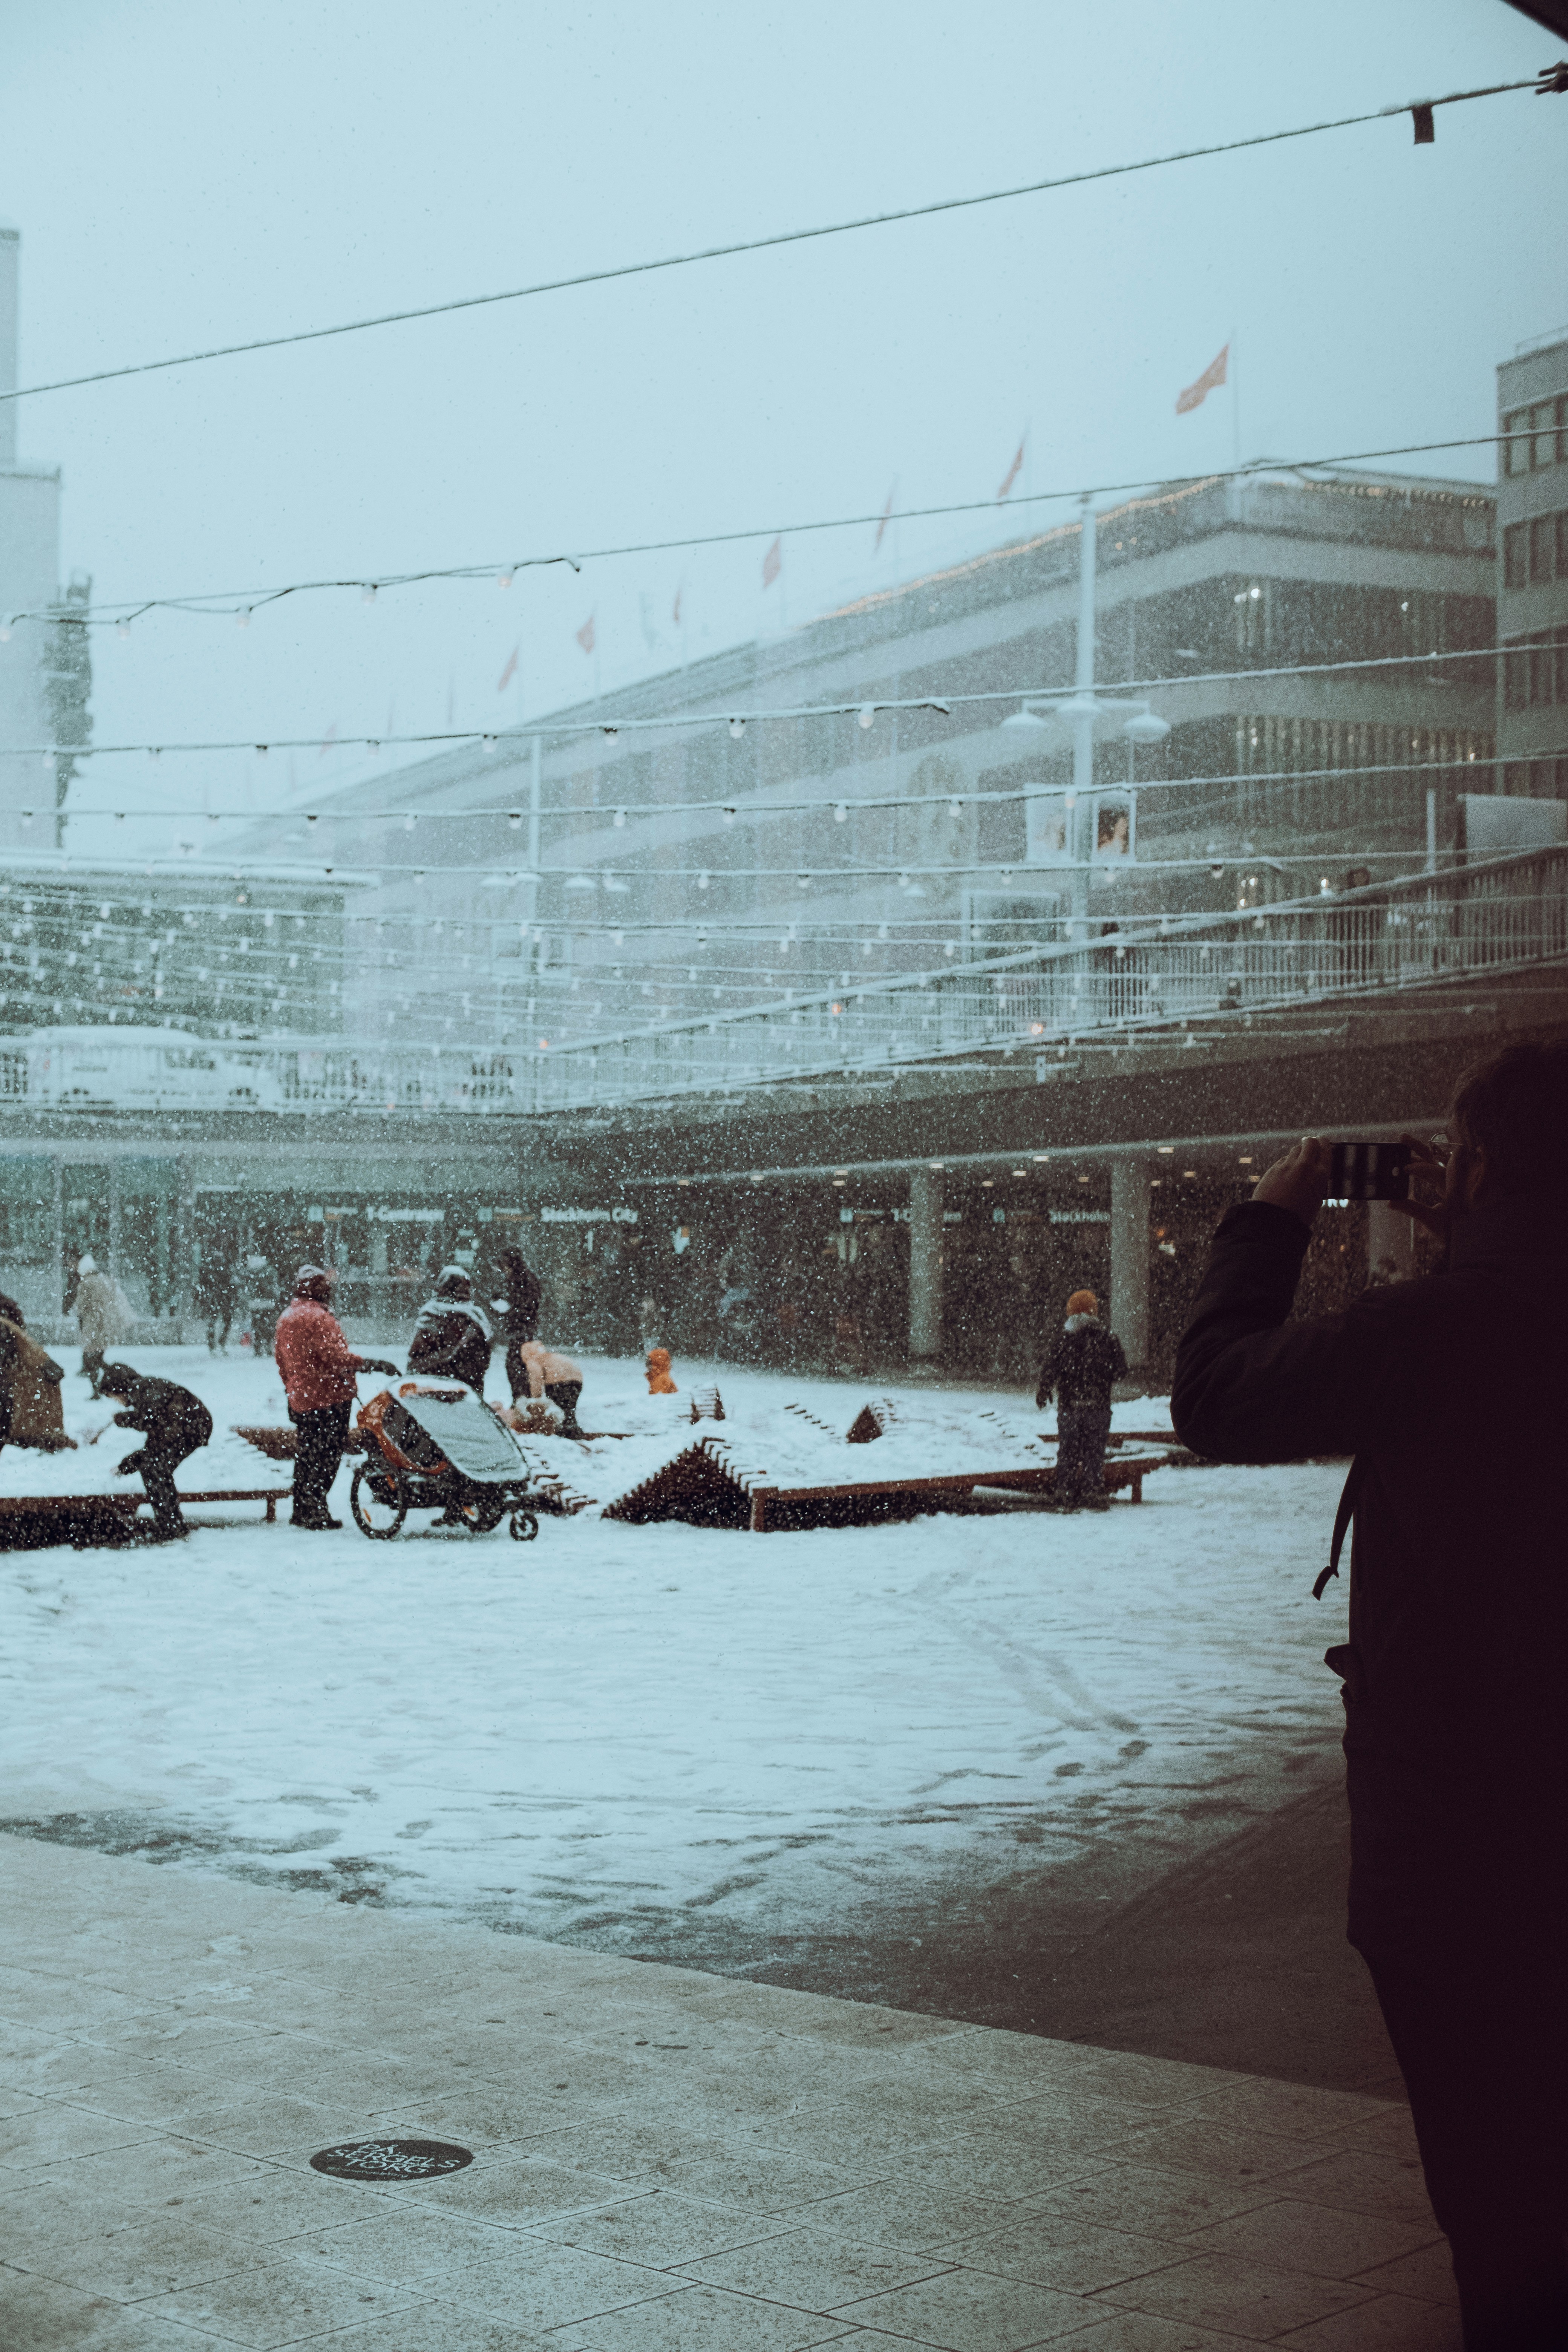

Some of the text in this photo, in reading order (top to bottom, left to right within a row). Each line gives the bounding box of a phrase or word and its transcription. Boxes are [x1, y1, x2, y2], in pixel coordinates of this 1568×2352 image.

[357, 2144, 398, 2154] PÅ
[327, 2149, 461, 2168] SERGELS
[346, 2159, 430, 2173] TORG
